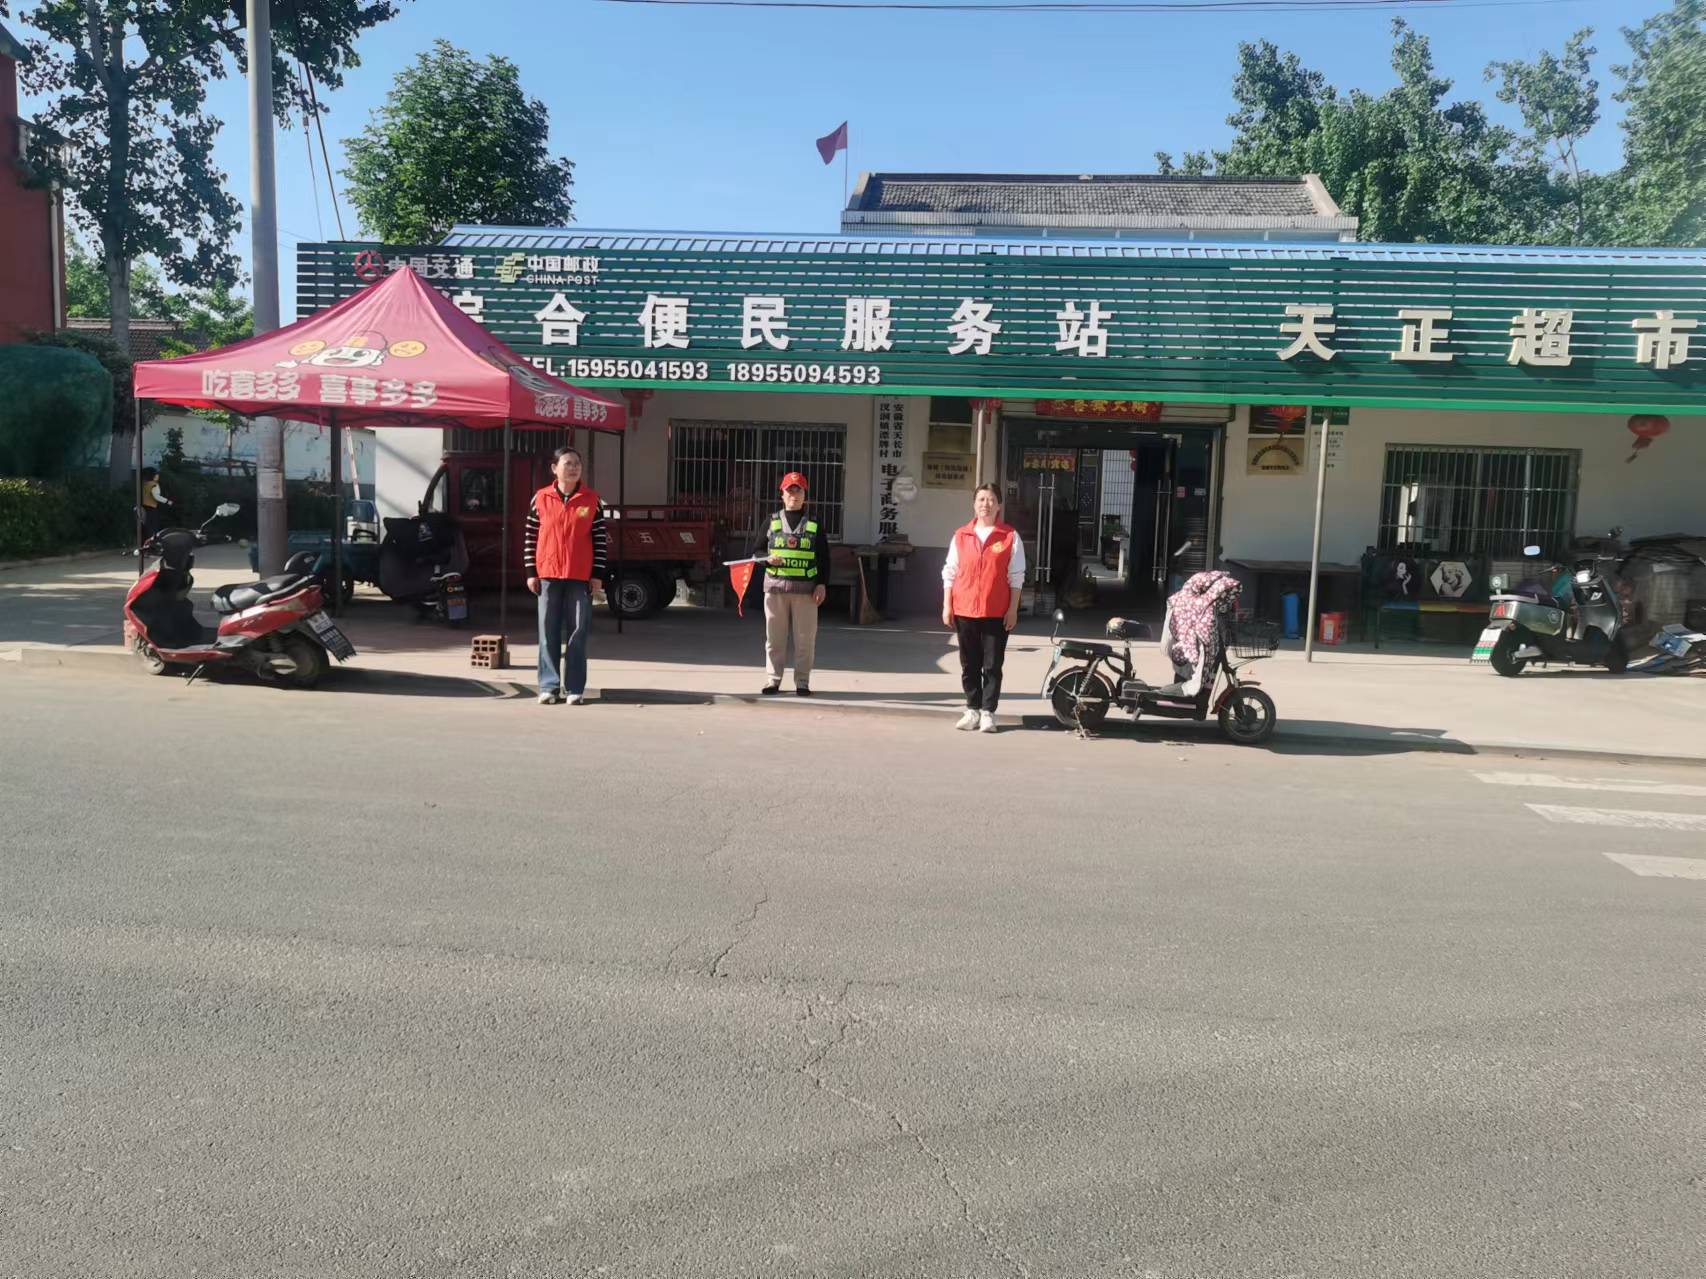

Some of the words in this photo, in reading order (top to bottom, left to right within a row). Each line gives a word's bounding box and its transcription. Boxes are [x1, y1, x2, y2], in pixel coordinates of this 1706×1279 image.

[388, 256, 474, 279] 中国交通
[527, 255, 600, 273] 中国邮政
[527, 275, 565, 285] CHINA
[567, 276, 599, 285] POST
[1276, 305, 1698, 369] 天正超市
[726, 363, 881, 384] 18955094593
[320, 374, 438, 408] 喜事多多
